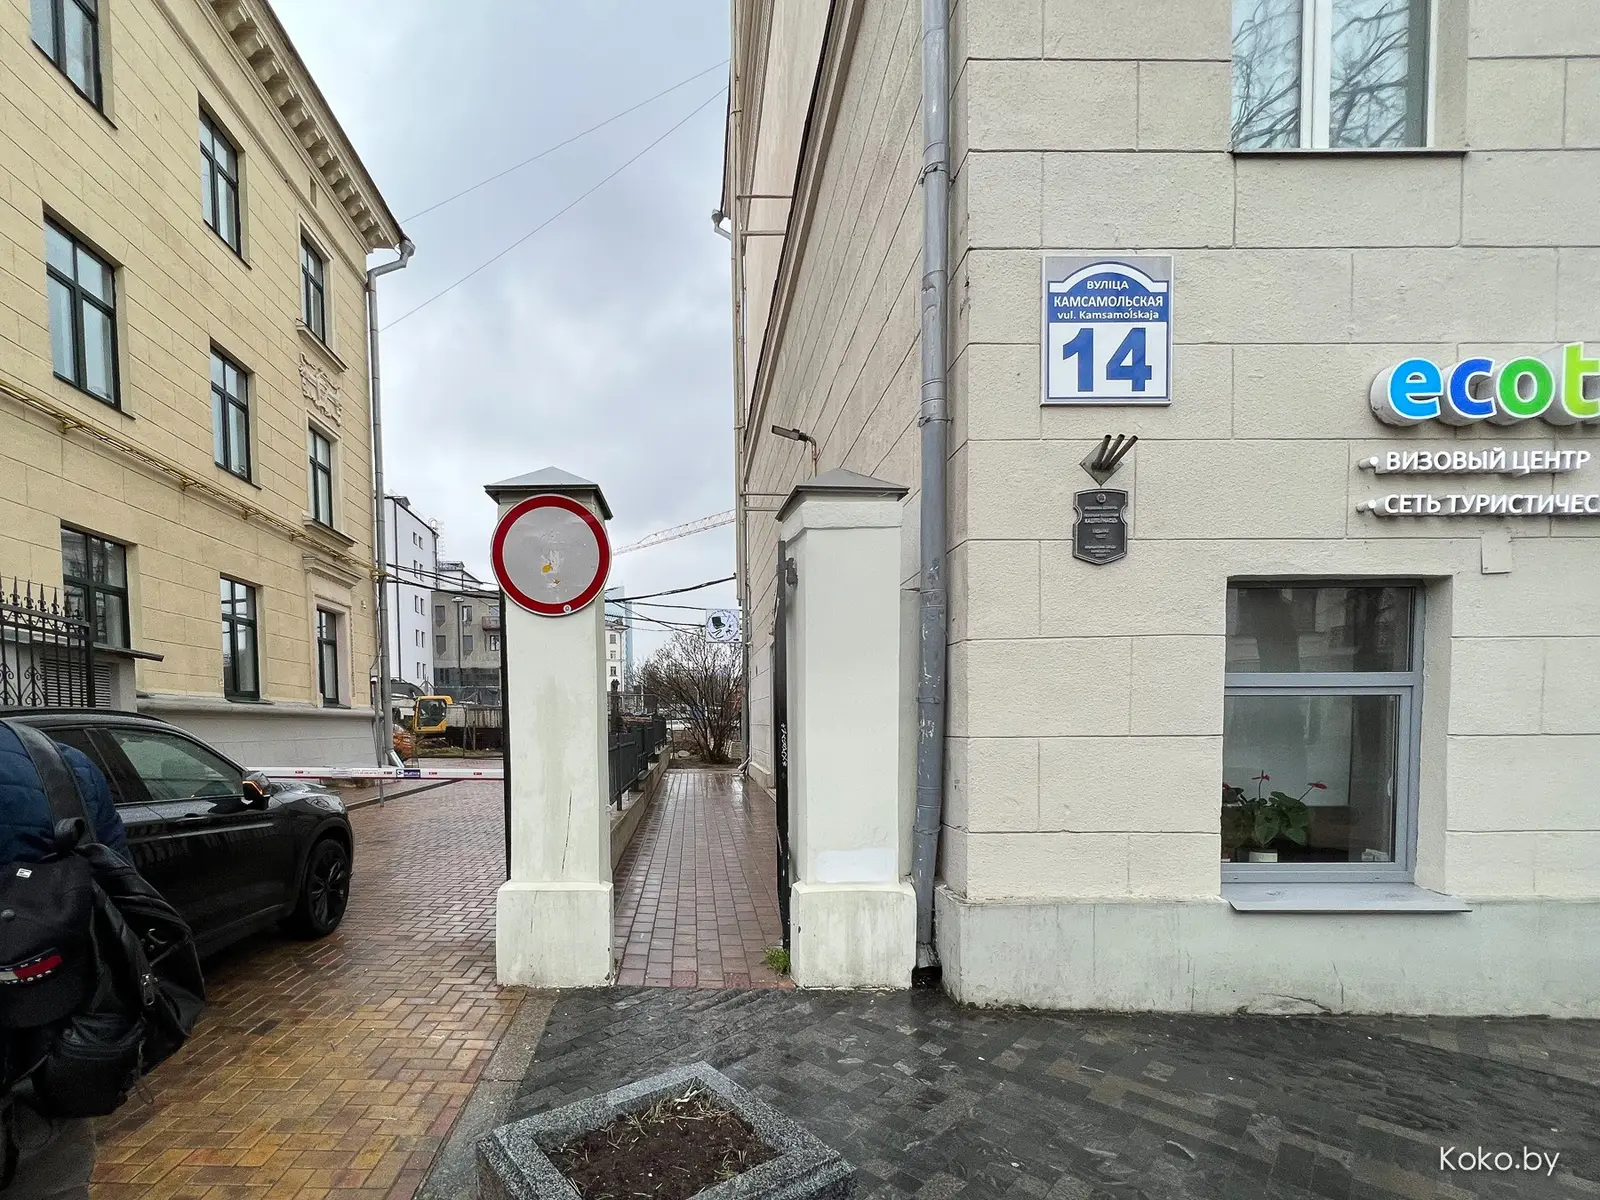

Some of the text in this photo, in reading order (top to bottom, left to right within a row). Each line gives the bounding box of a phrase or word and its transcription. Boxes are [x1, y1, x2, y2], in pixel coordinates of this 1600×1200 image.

[1086, 280, 1129, 291] ВУЛІЦА
[1054, 295, 1163, 307] КАМСАМОЛЬСКАЯ
[1057, 310, 1076, 320] vul.
[1062, 327, 1152, 392] 14
[1387, 342, 1600, 419] ecot
[1386, 447, 1591, 473] ВИЗОВЫЙ ЦЕНТР
[1384, 494, 1600, 513] СЕТЬ ТУРИСТИЧЕС
